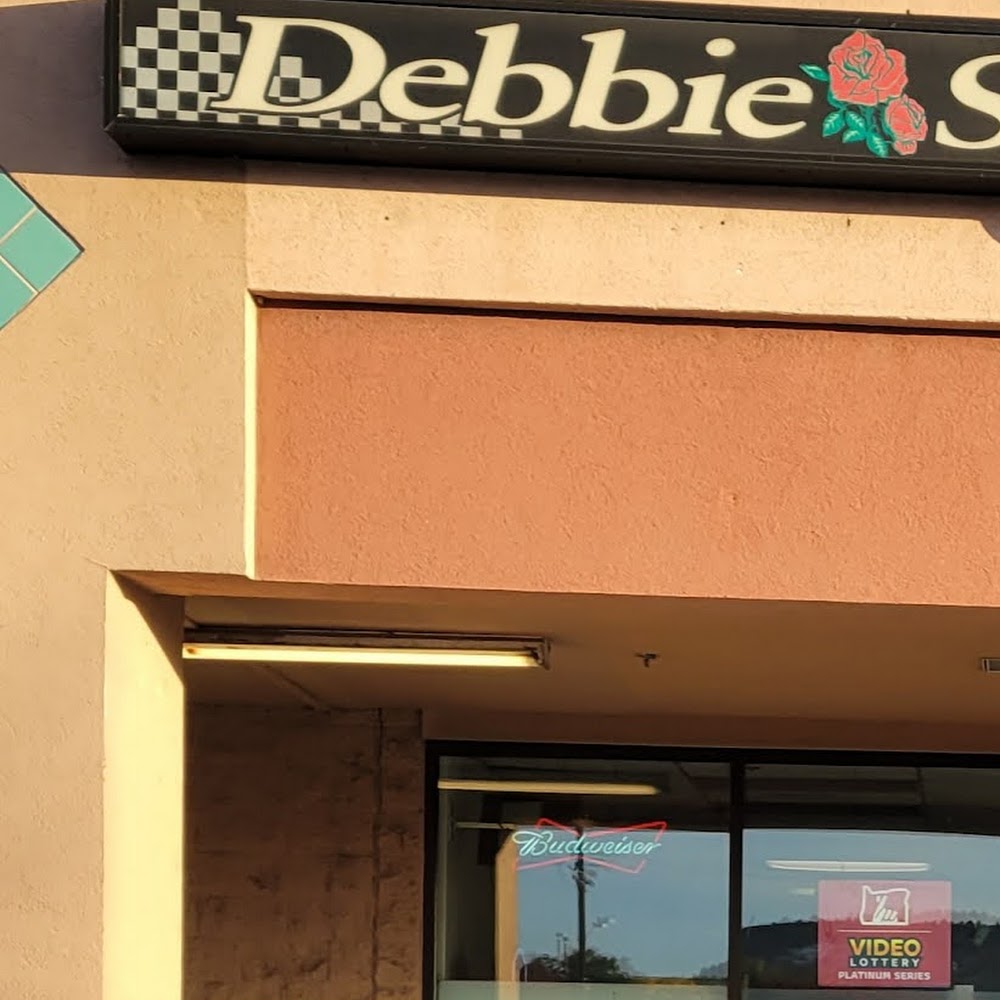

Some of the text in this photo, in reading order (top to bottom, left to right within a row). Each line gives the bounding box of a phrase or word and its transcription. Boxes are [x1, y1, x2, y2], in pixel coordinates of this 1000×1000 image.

[209, 16, 813, 139] Debbie
[512, 831, 661, 857] Budweiser
[849, 938, 922, 957] VIDEO
[850, 958, 920, 967] LOTTERY
[838, 971, 931, 981] PLATINUM SERIES
